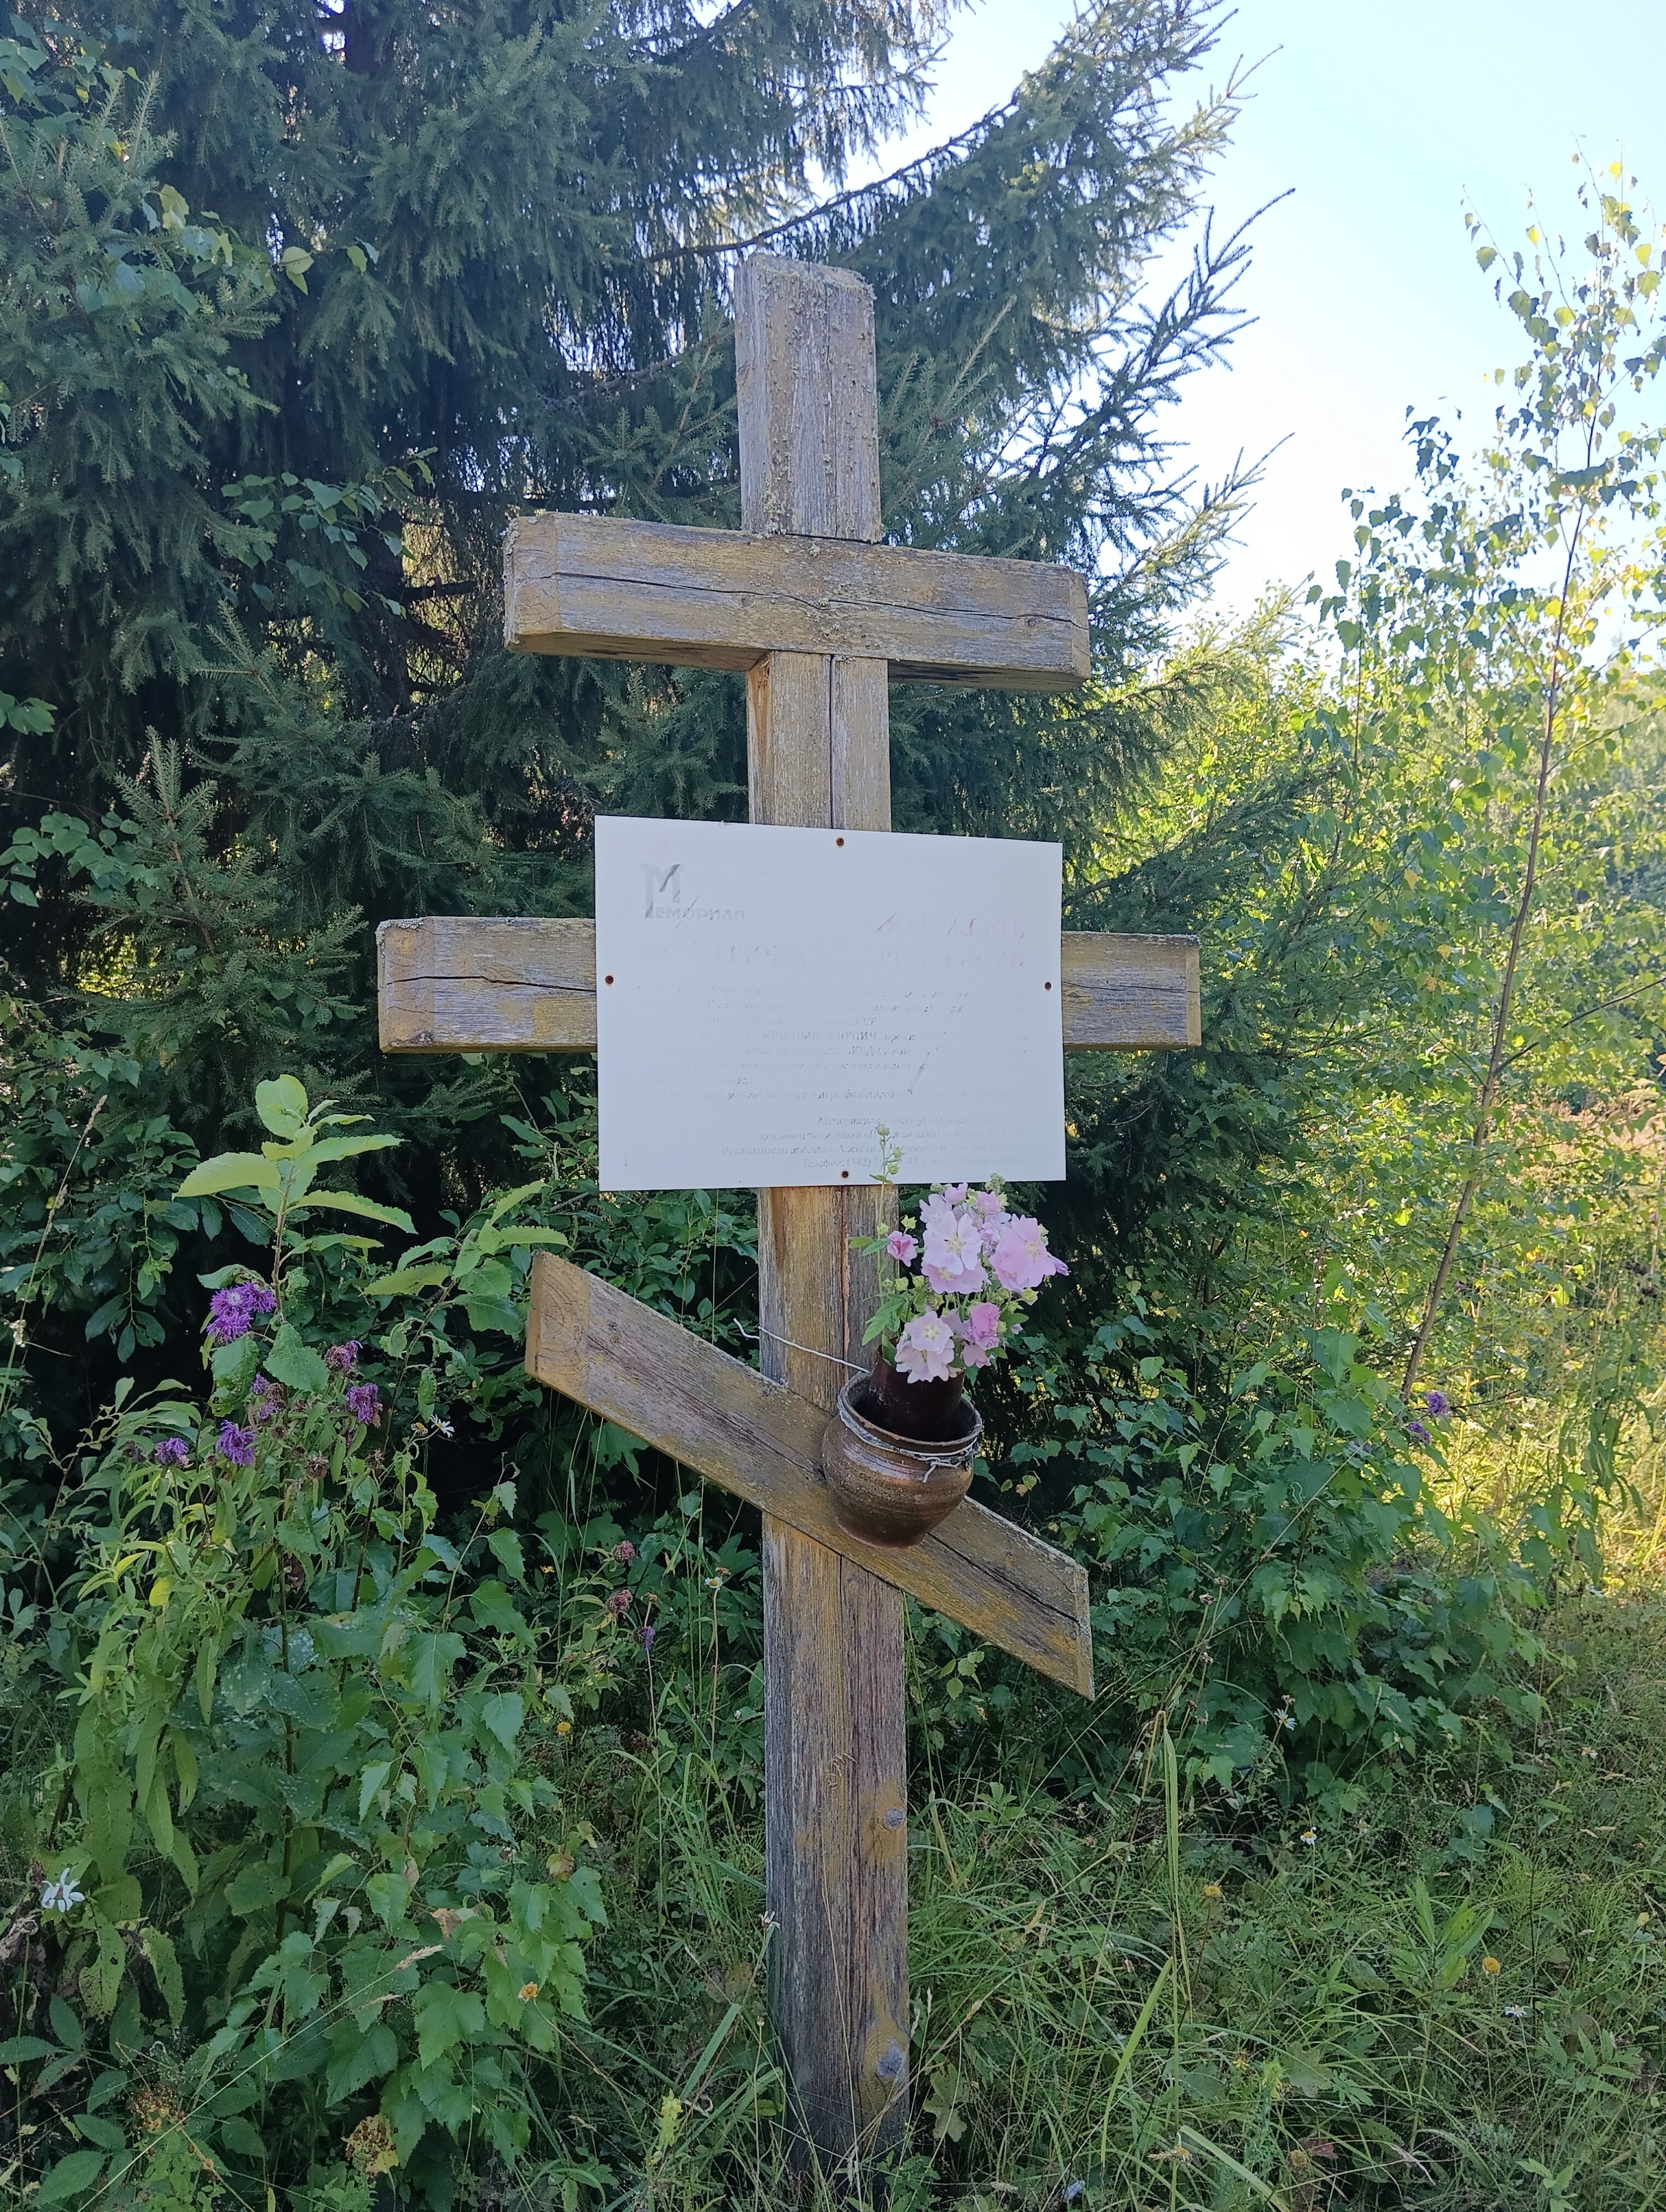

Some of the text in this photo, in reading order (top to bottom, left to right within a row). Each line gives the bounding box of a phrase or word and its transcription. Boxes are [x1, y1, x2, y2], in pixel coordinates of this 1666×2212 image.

[762, 1028, 820, 1040] КРАСНЫЙ
[828, 1030, 877, 1041] КИРПИЧ
[722, 1146, 788, 1157] Руководители
[802, 1157, 844, 1169] Телефон:
[846, 1156, 871, 1167] (342)
